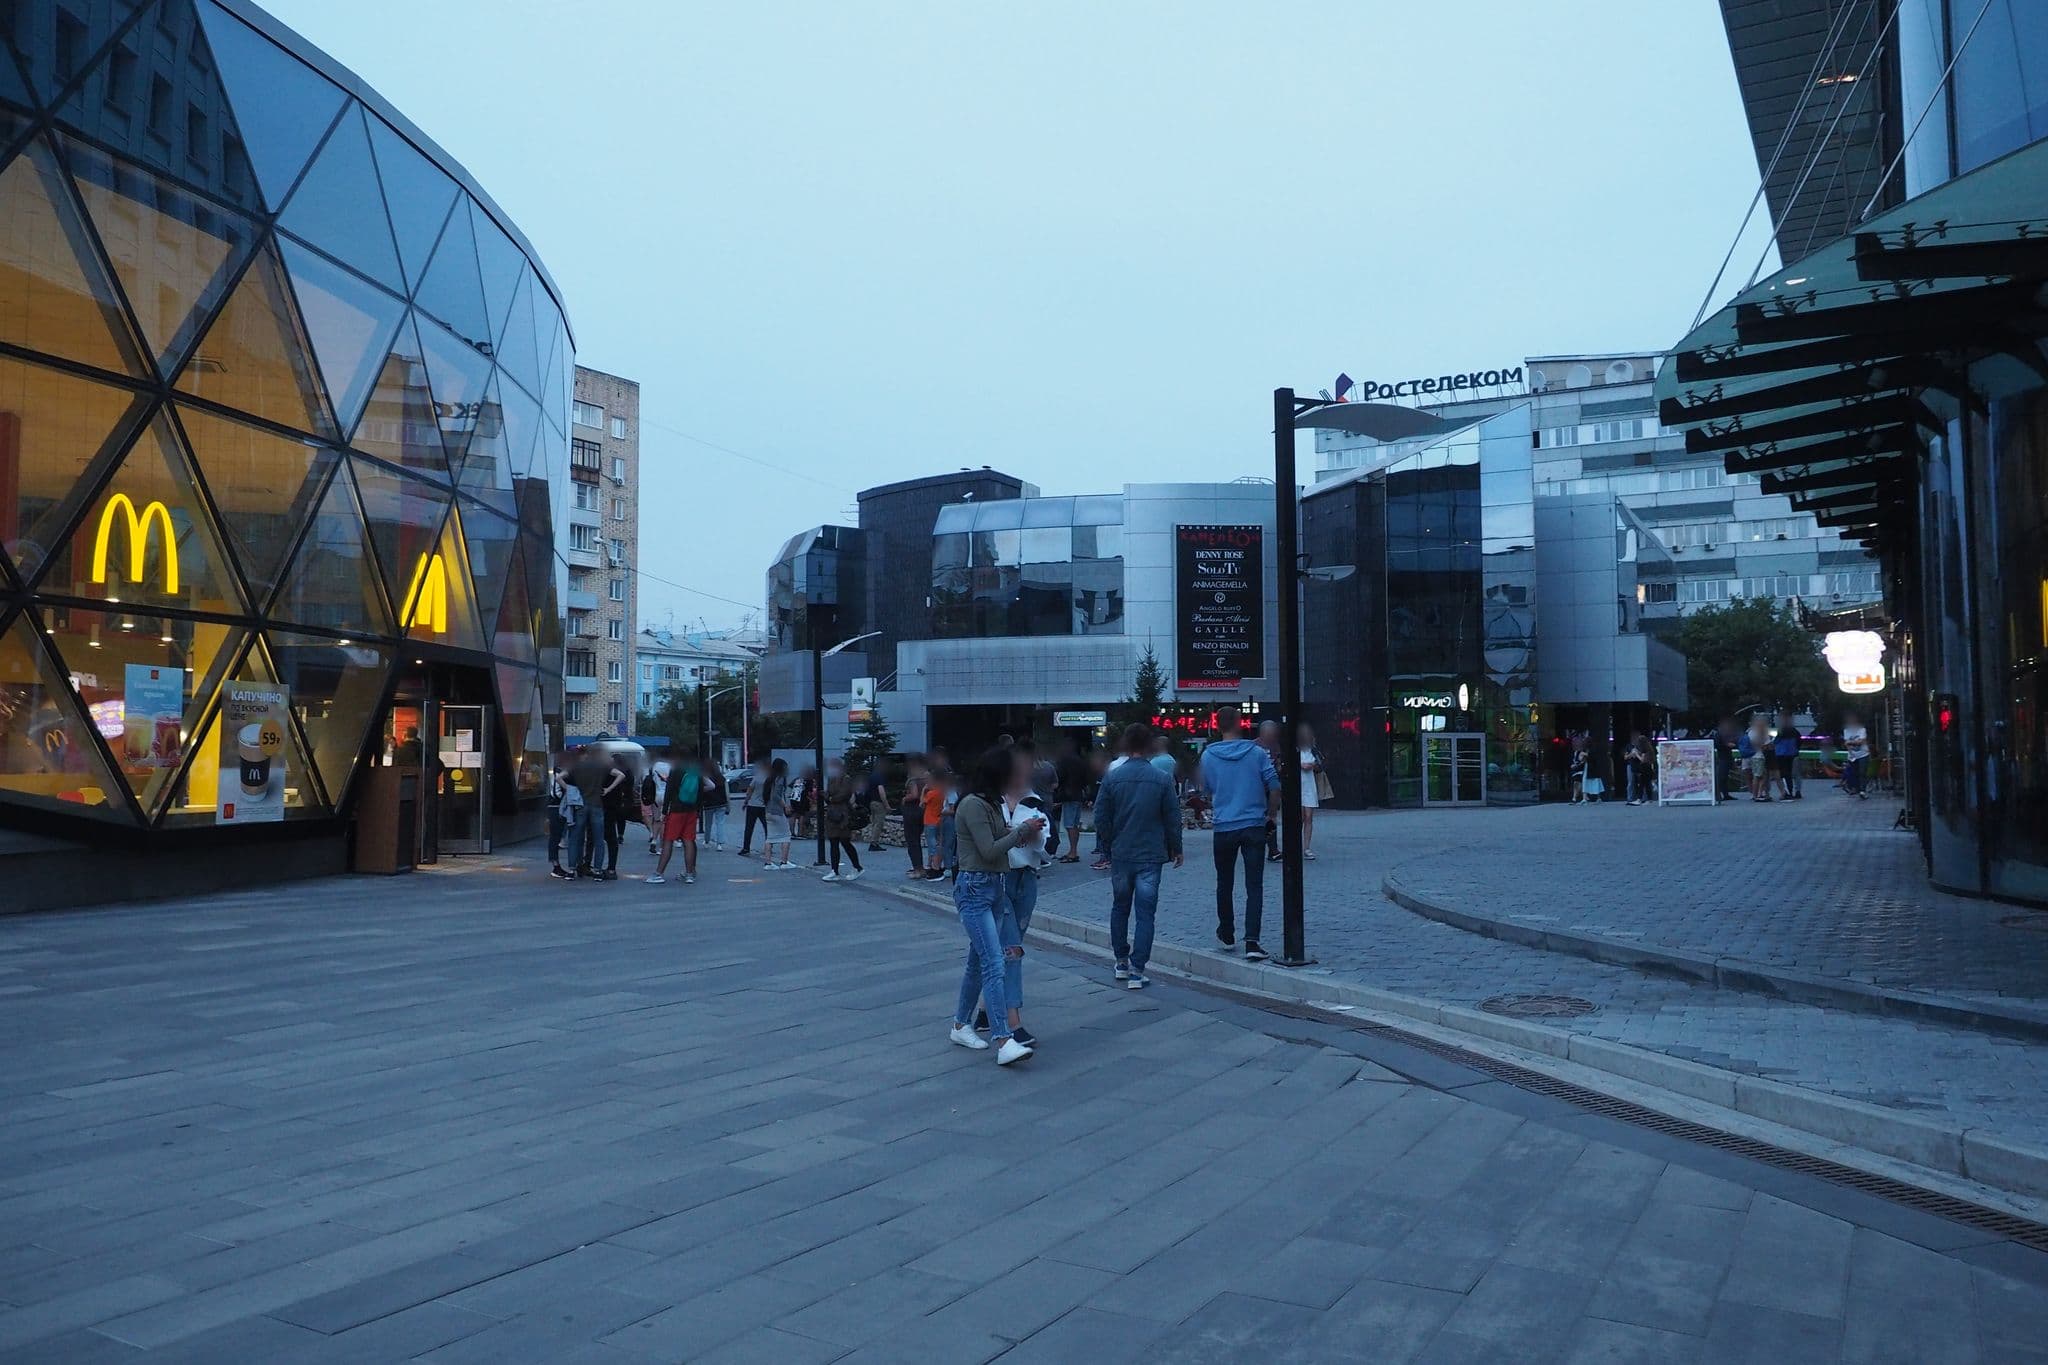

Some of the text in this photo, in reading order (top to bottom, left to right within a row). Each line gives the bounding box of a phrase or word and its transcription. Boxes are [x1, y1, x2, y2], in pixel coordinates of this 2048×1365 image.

[1363, 366, 1523, 401] Ростелеком
[1195, 550, 1221, 559] DENNY
[231, 689, 282, 704] КАПУЧИНО
